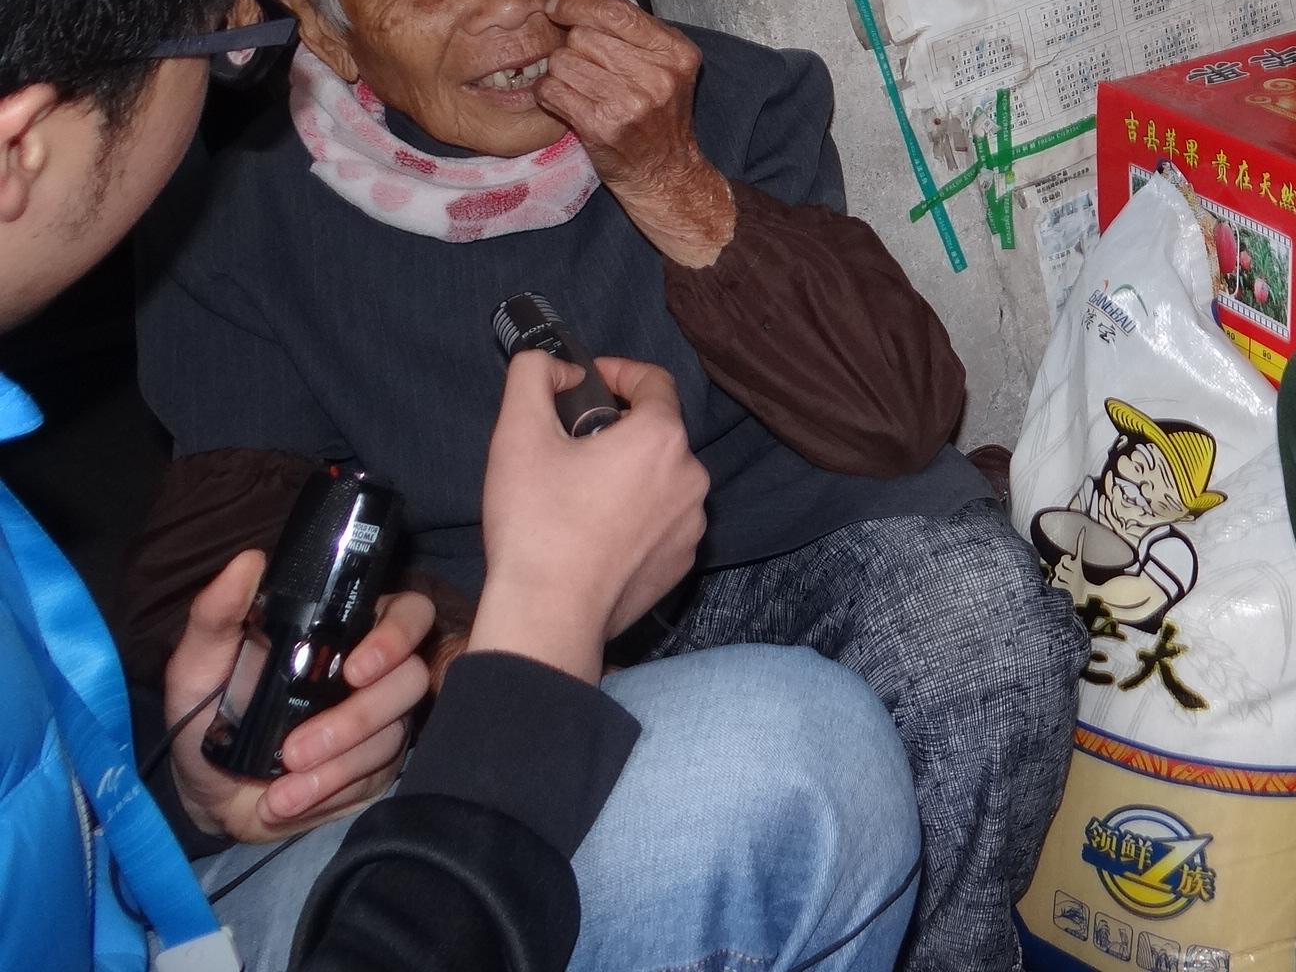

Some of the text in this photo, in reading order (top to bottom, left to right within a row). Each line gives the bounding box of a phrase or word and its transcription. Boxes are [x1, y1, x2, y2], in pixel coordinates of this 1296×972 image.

[1125, 110, 1296, 214] 吉县苹果 贵在天然
[352, 530, 375, 541] HOME
